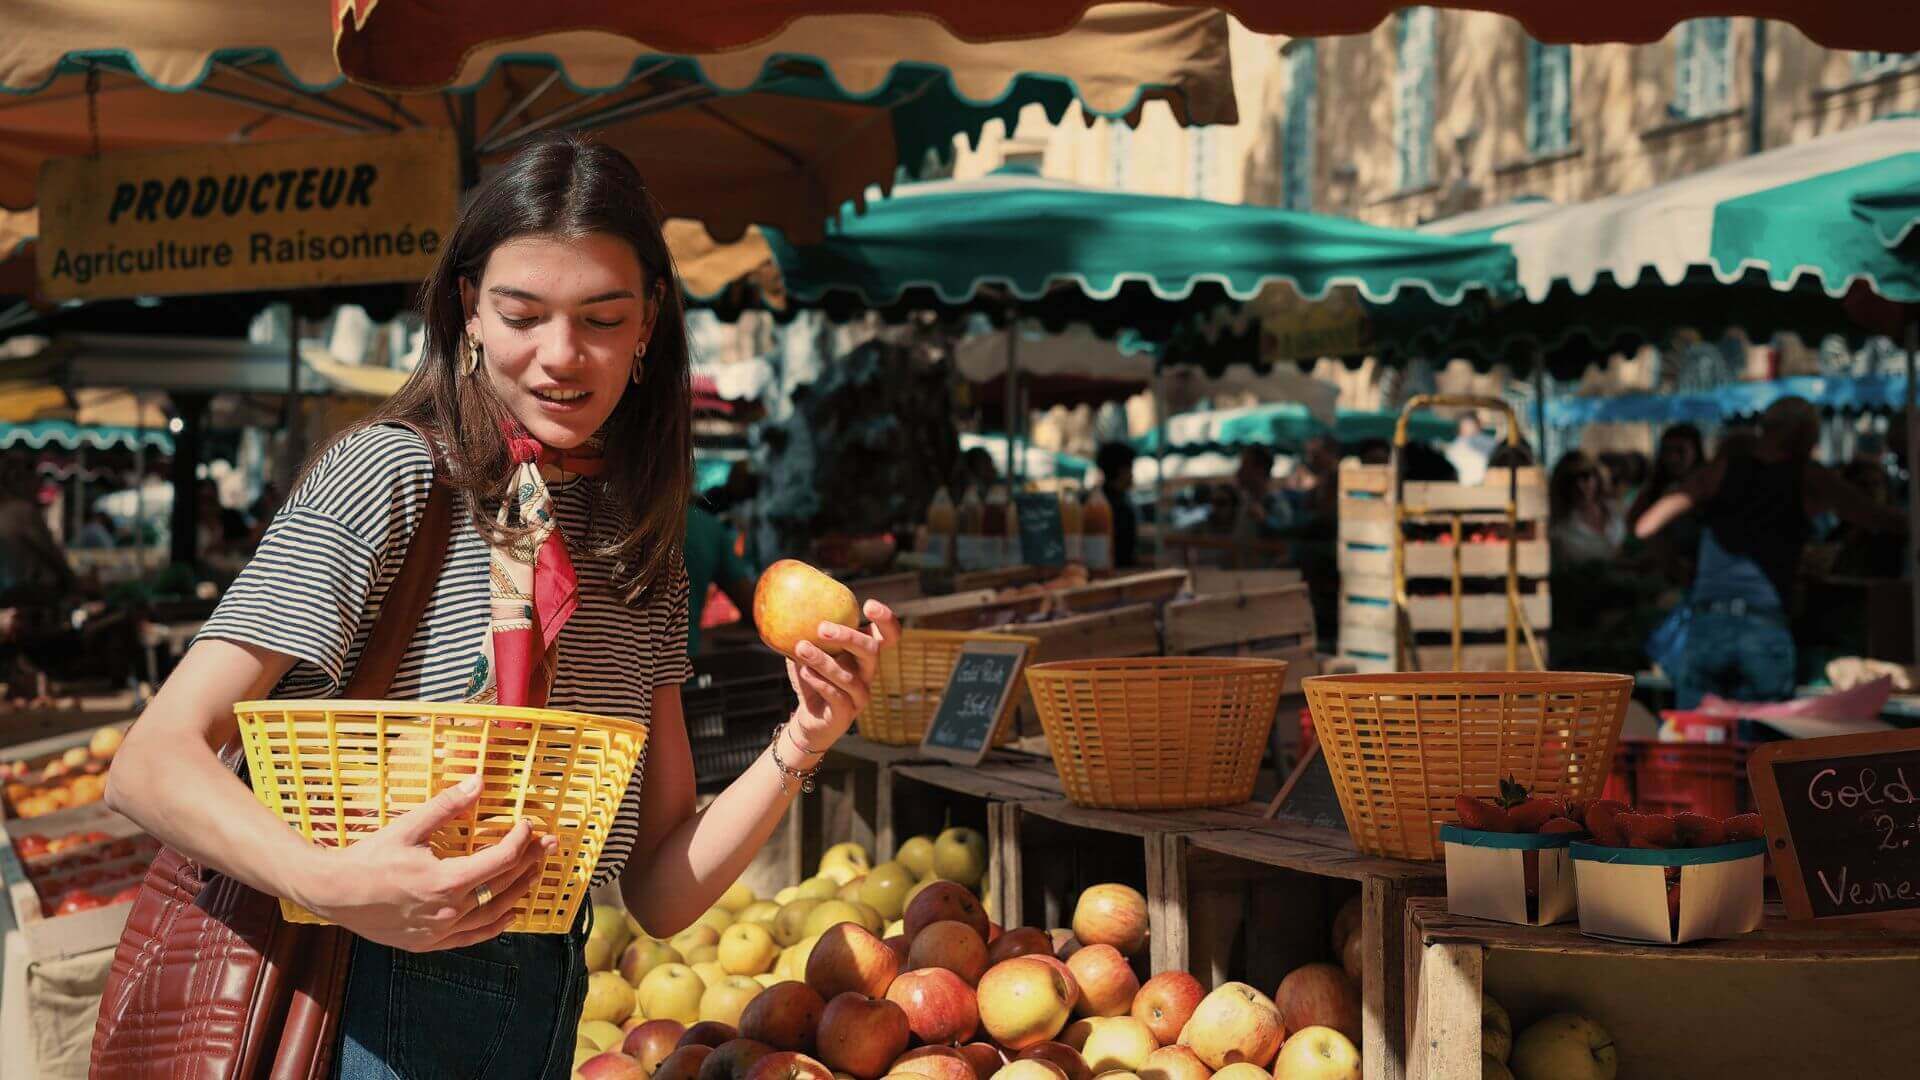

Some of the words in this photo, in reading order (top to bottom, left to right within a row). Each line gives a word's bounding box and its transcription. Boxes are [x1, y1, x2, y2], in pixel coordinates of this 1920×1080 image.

[108, 163, 378, 224] PRODUCTEUR
[51, 240, 233, 284] Agriculture
[249, 224, 441, 265] Raisonnée
[1818, 866, 1920, 905] Vene
